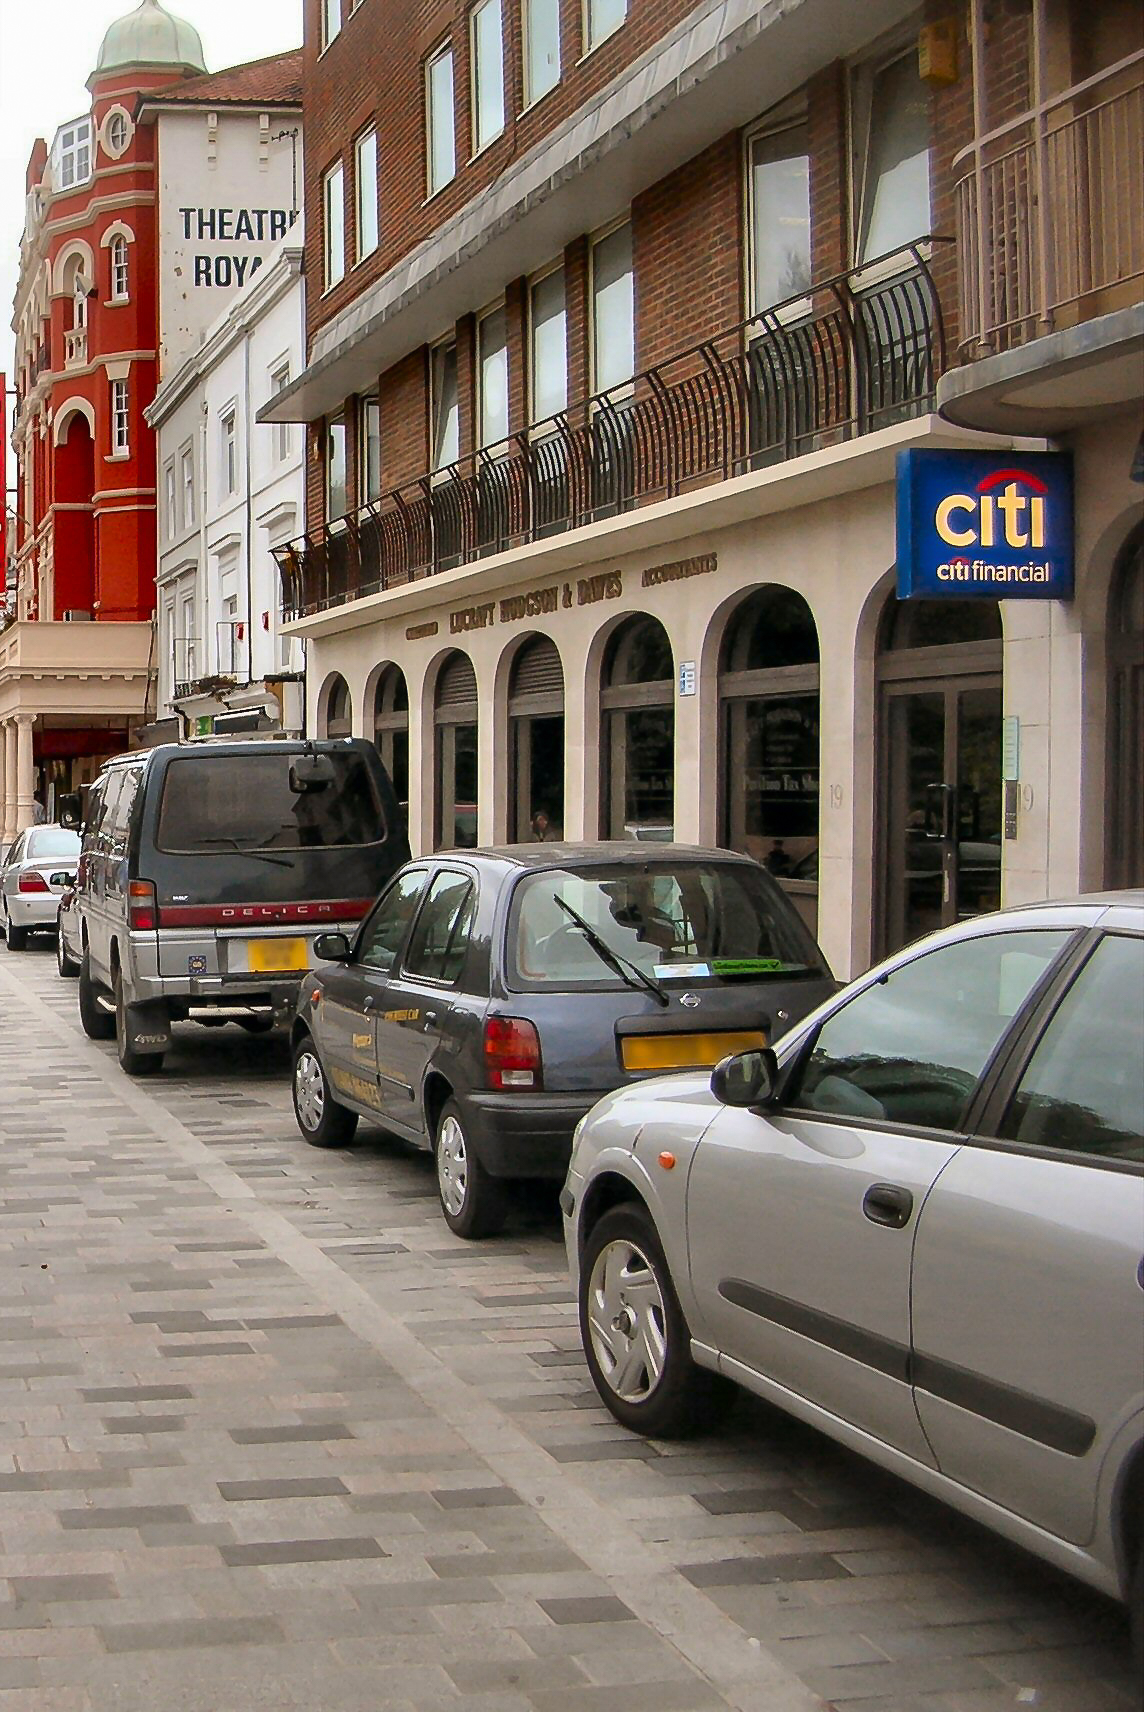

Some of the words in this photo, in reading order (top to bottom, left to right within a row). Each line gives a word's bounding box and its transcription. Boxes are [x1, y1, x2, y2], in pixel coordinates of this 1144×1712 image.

[935, 482, 1045, 548] citi
[562, 583, 573, 609] &
[830, 783, 844, 810] 19
[222, 905, 331, 917] DELICA
